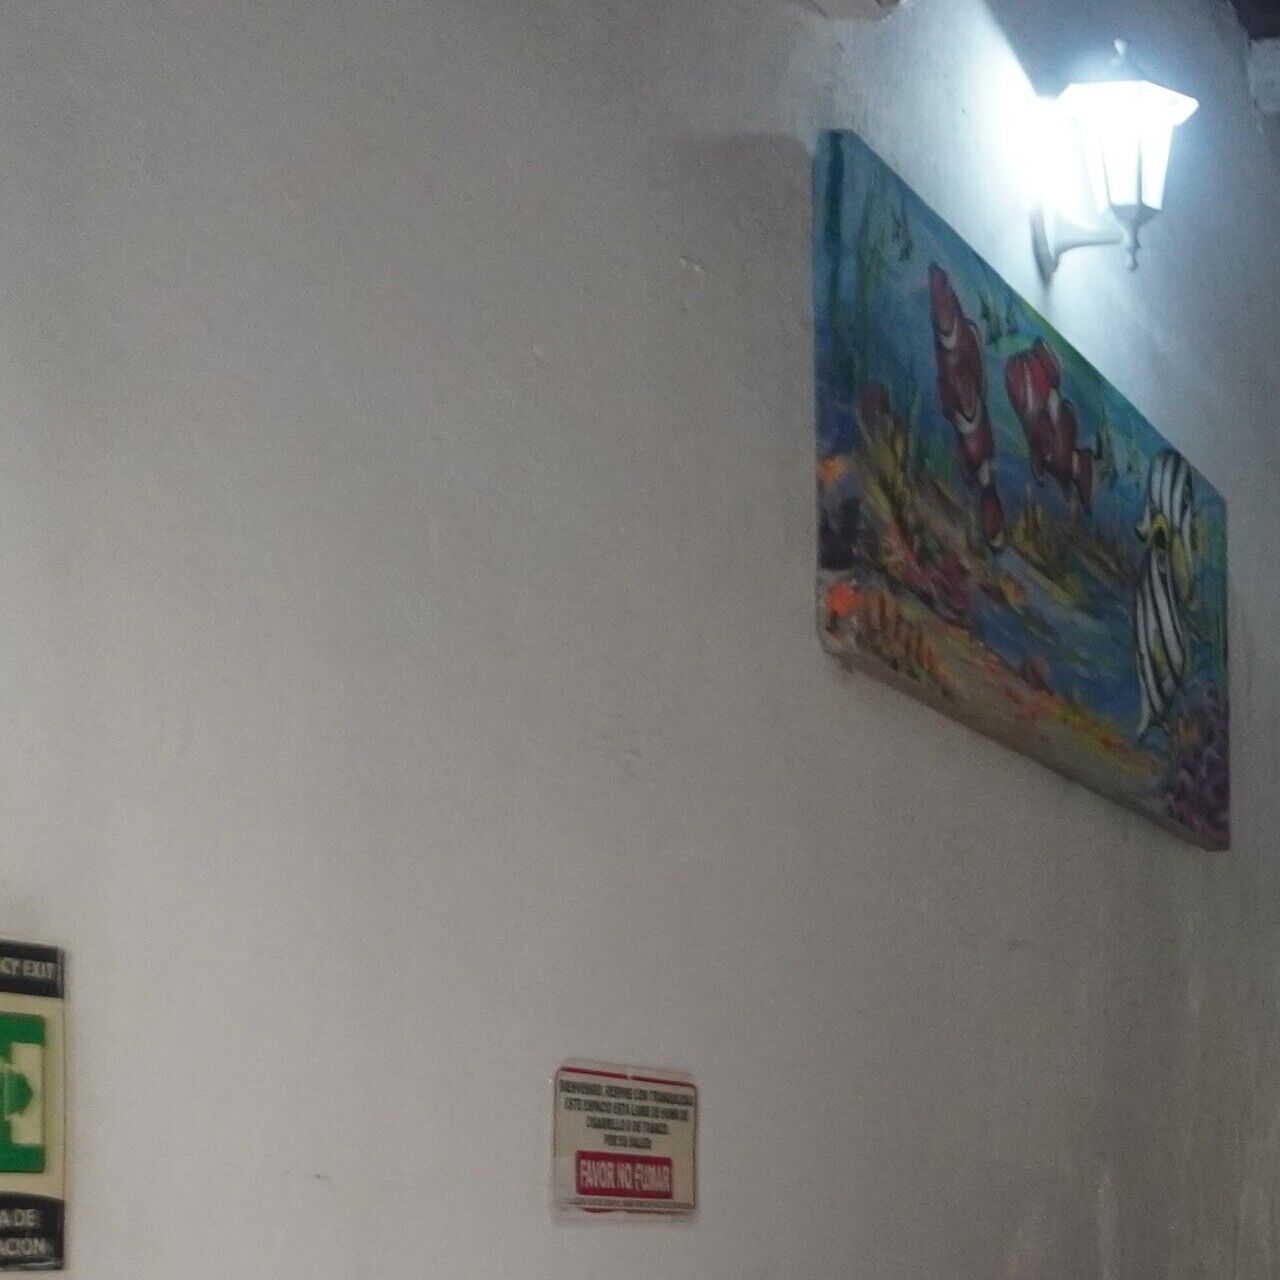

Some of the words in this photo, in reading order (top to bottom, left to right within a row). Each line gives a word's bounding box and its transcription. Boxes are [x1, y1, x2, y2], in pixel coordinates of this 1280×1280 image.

[22, 960, 54, 979] EXIT
[580, 1159, 615, 1189] FAVOR
[616, 1162, 633, 1190] NO
[634, 1163, 670, 1193] FUMAR
[13, 1208, 37, 1227] DE
